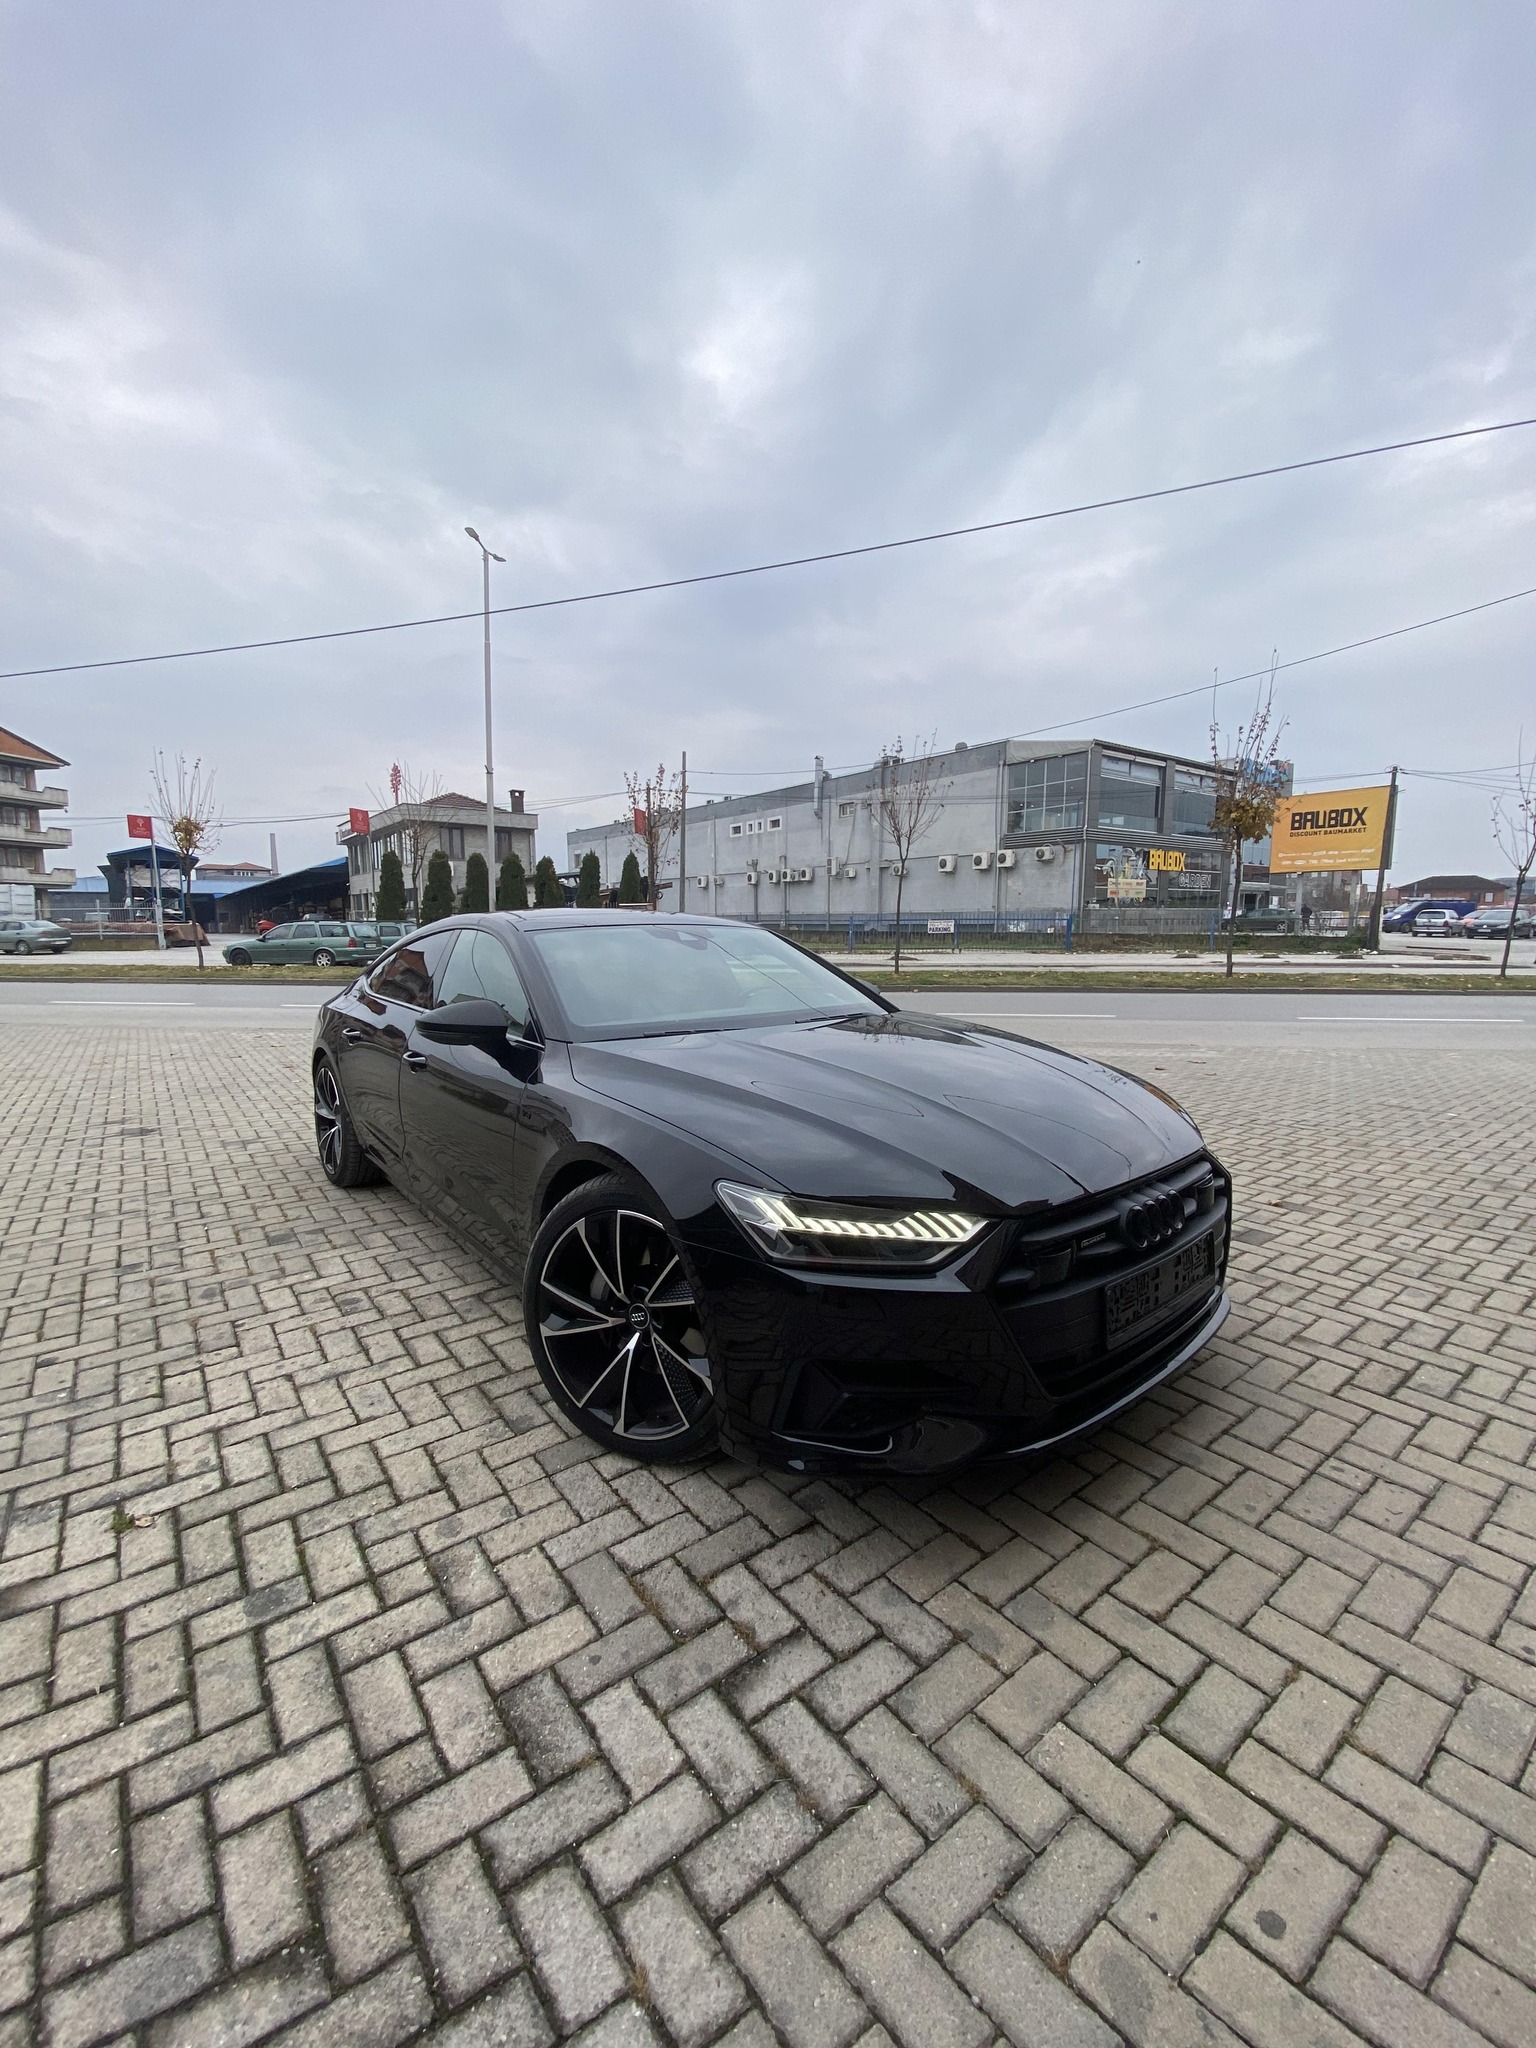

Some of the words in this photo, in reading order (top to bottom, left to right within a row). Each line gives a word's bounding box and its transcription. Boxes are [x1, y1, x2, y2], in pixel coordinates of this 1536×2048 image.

[1291, 807, 1368, 830] BAUBOX
[1289, 830, 1322, 838] DISCOUNT
[1323, 827, 1367, 836] BAUMARKET
[1149, 849, 1186, 871] BAUBOX
[1179, 873, 1211, 888] GARDEN
